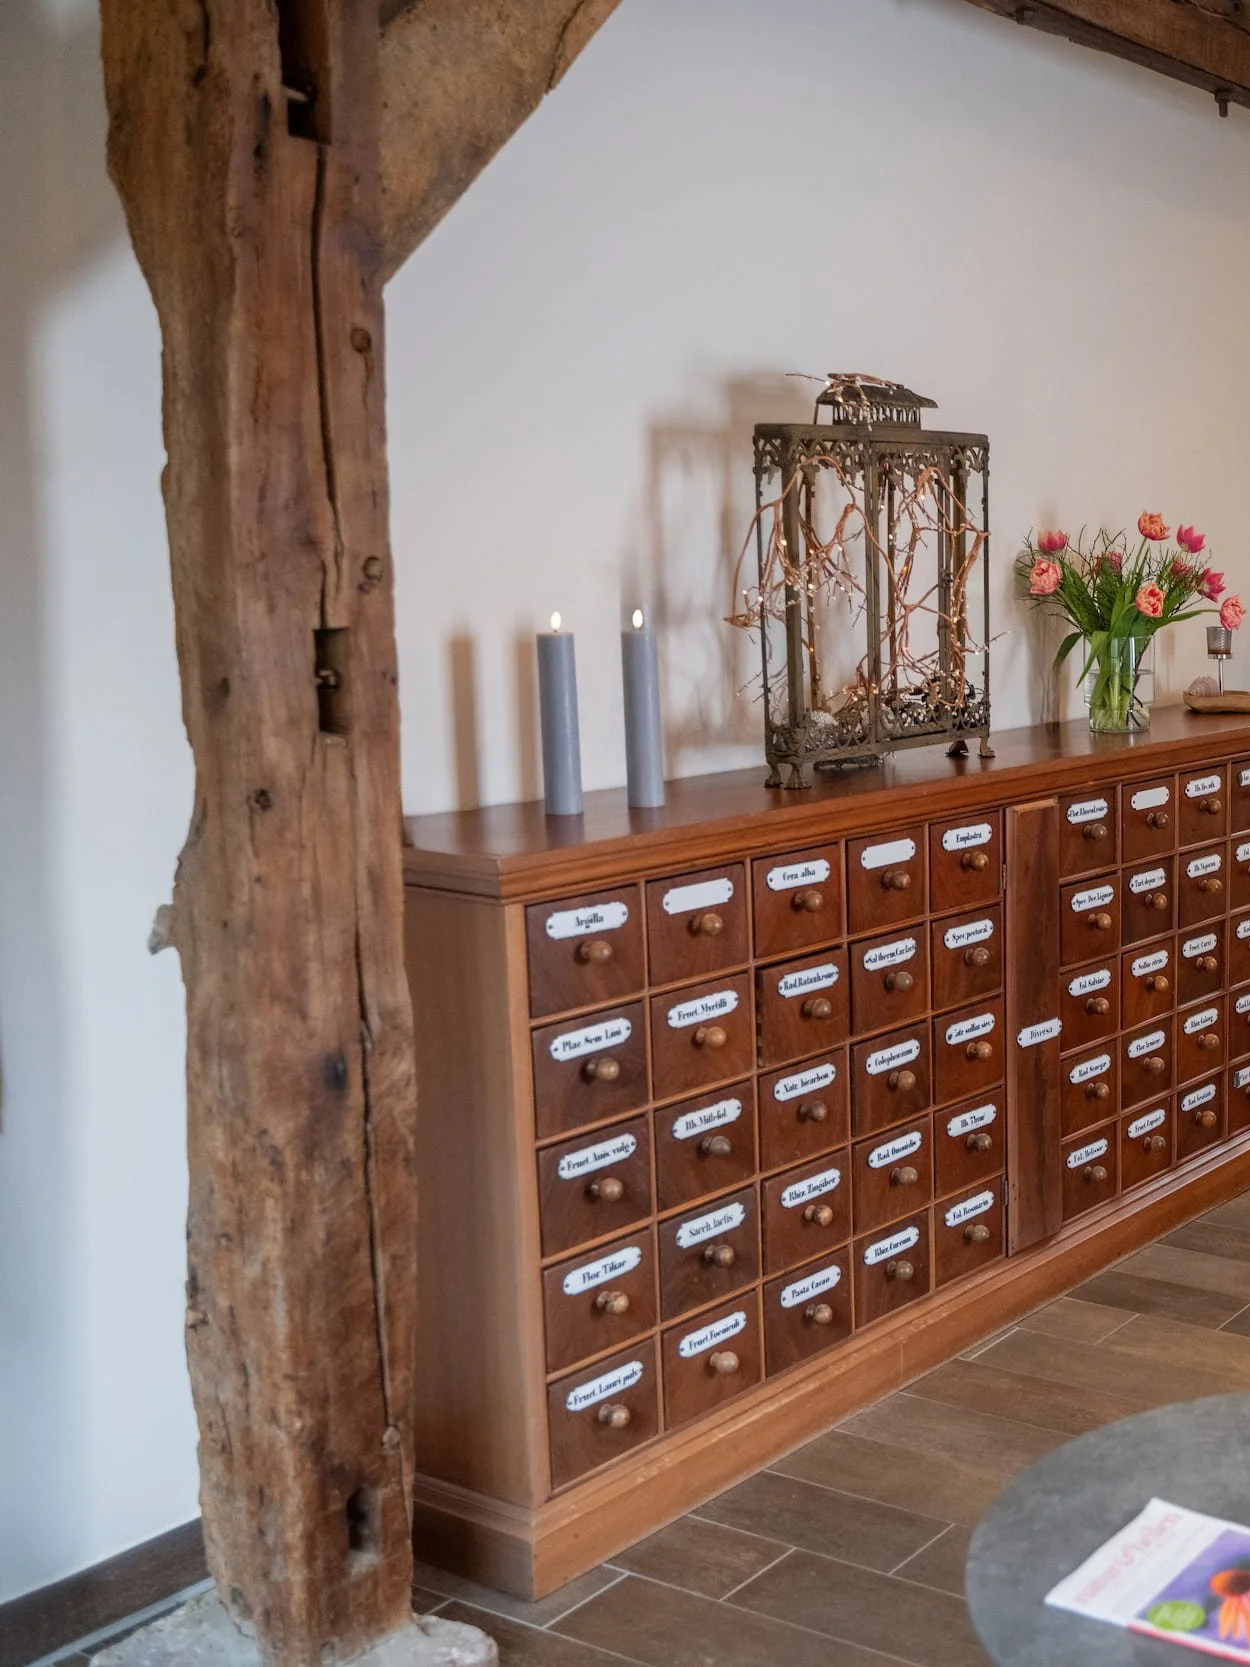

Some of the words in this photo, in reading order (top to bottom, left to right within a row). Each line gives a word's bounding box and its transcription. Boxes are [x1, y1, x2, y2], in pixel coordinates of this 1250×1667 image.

[575, 912, 605, 930] Argilla
[791, 1286, 810, 1299] Pasta
[810, 1276, 831, 1290] Cacao
